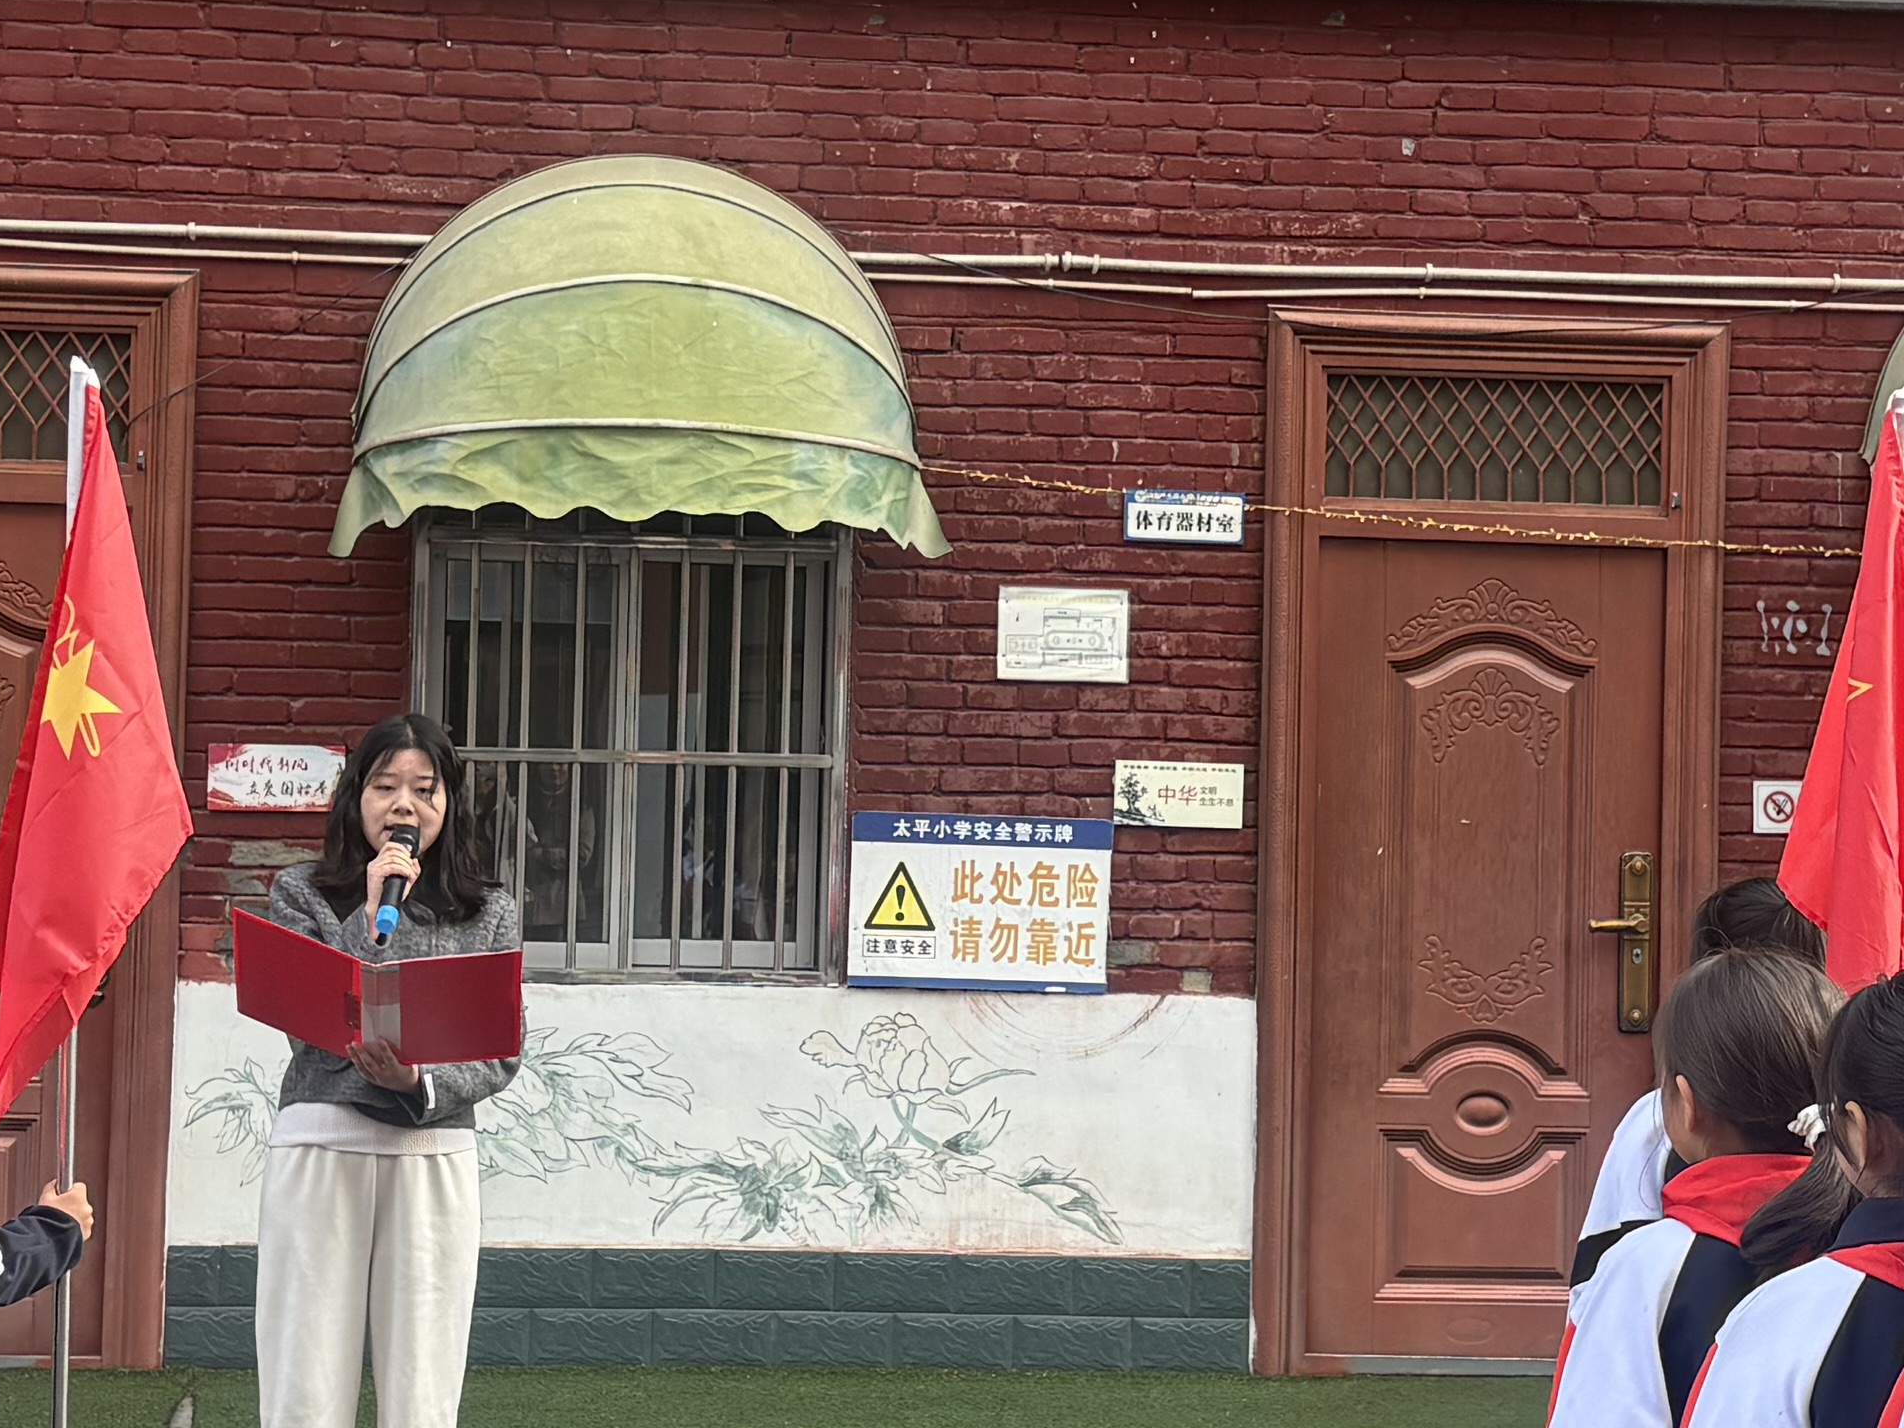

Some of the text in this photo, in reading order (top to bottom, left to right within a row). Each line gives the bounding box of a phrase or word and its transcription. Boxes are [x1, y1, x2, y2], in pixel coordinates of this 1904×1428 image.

[1136, 509, 1235, 533] 体育器材室
[1158, 785, 1197, 806] 中华
[893, 819, 1074, 843] 太平小学安全警示牌
[951, 859, 1099, 909] 此处危险
[865, 938, 933, 955] 注意安全
[949, 916, 1097, 967] 请勿靠近
